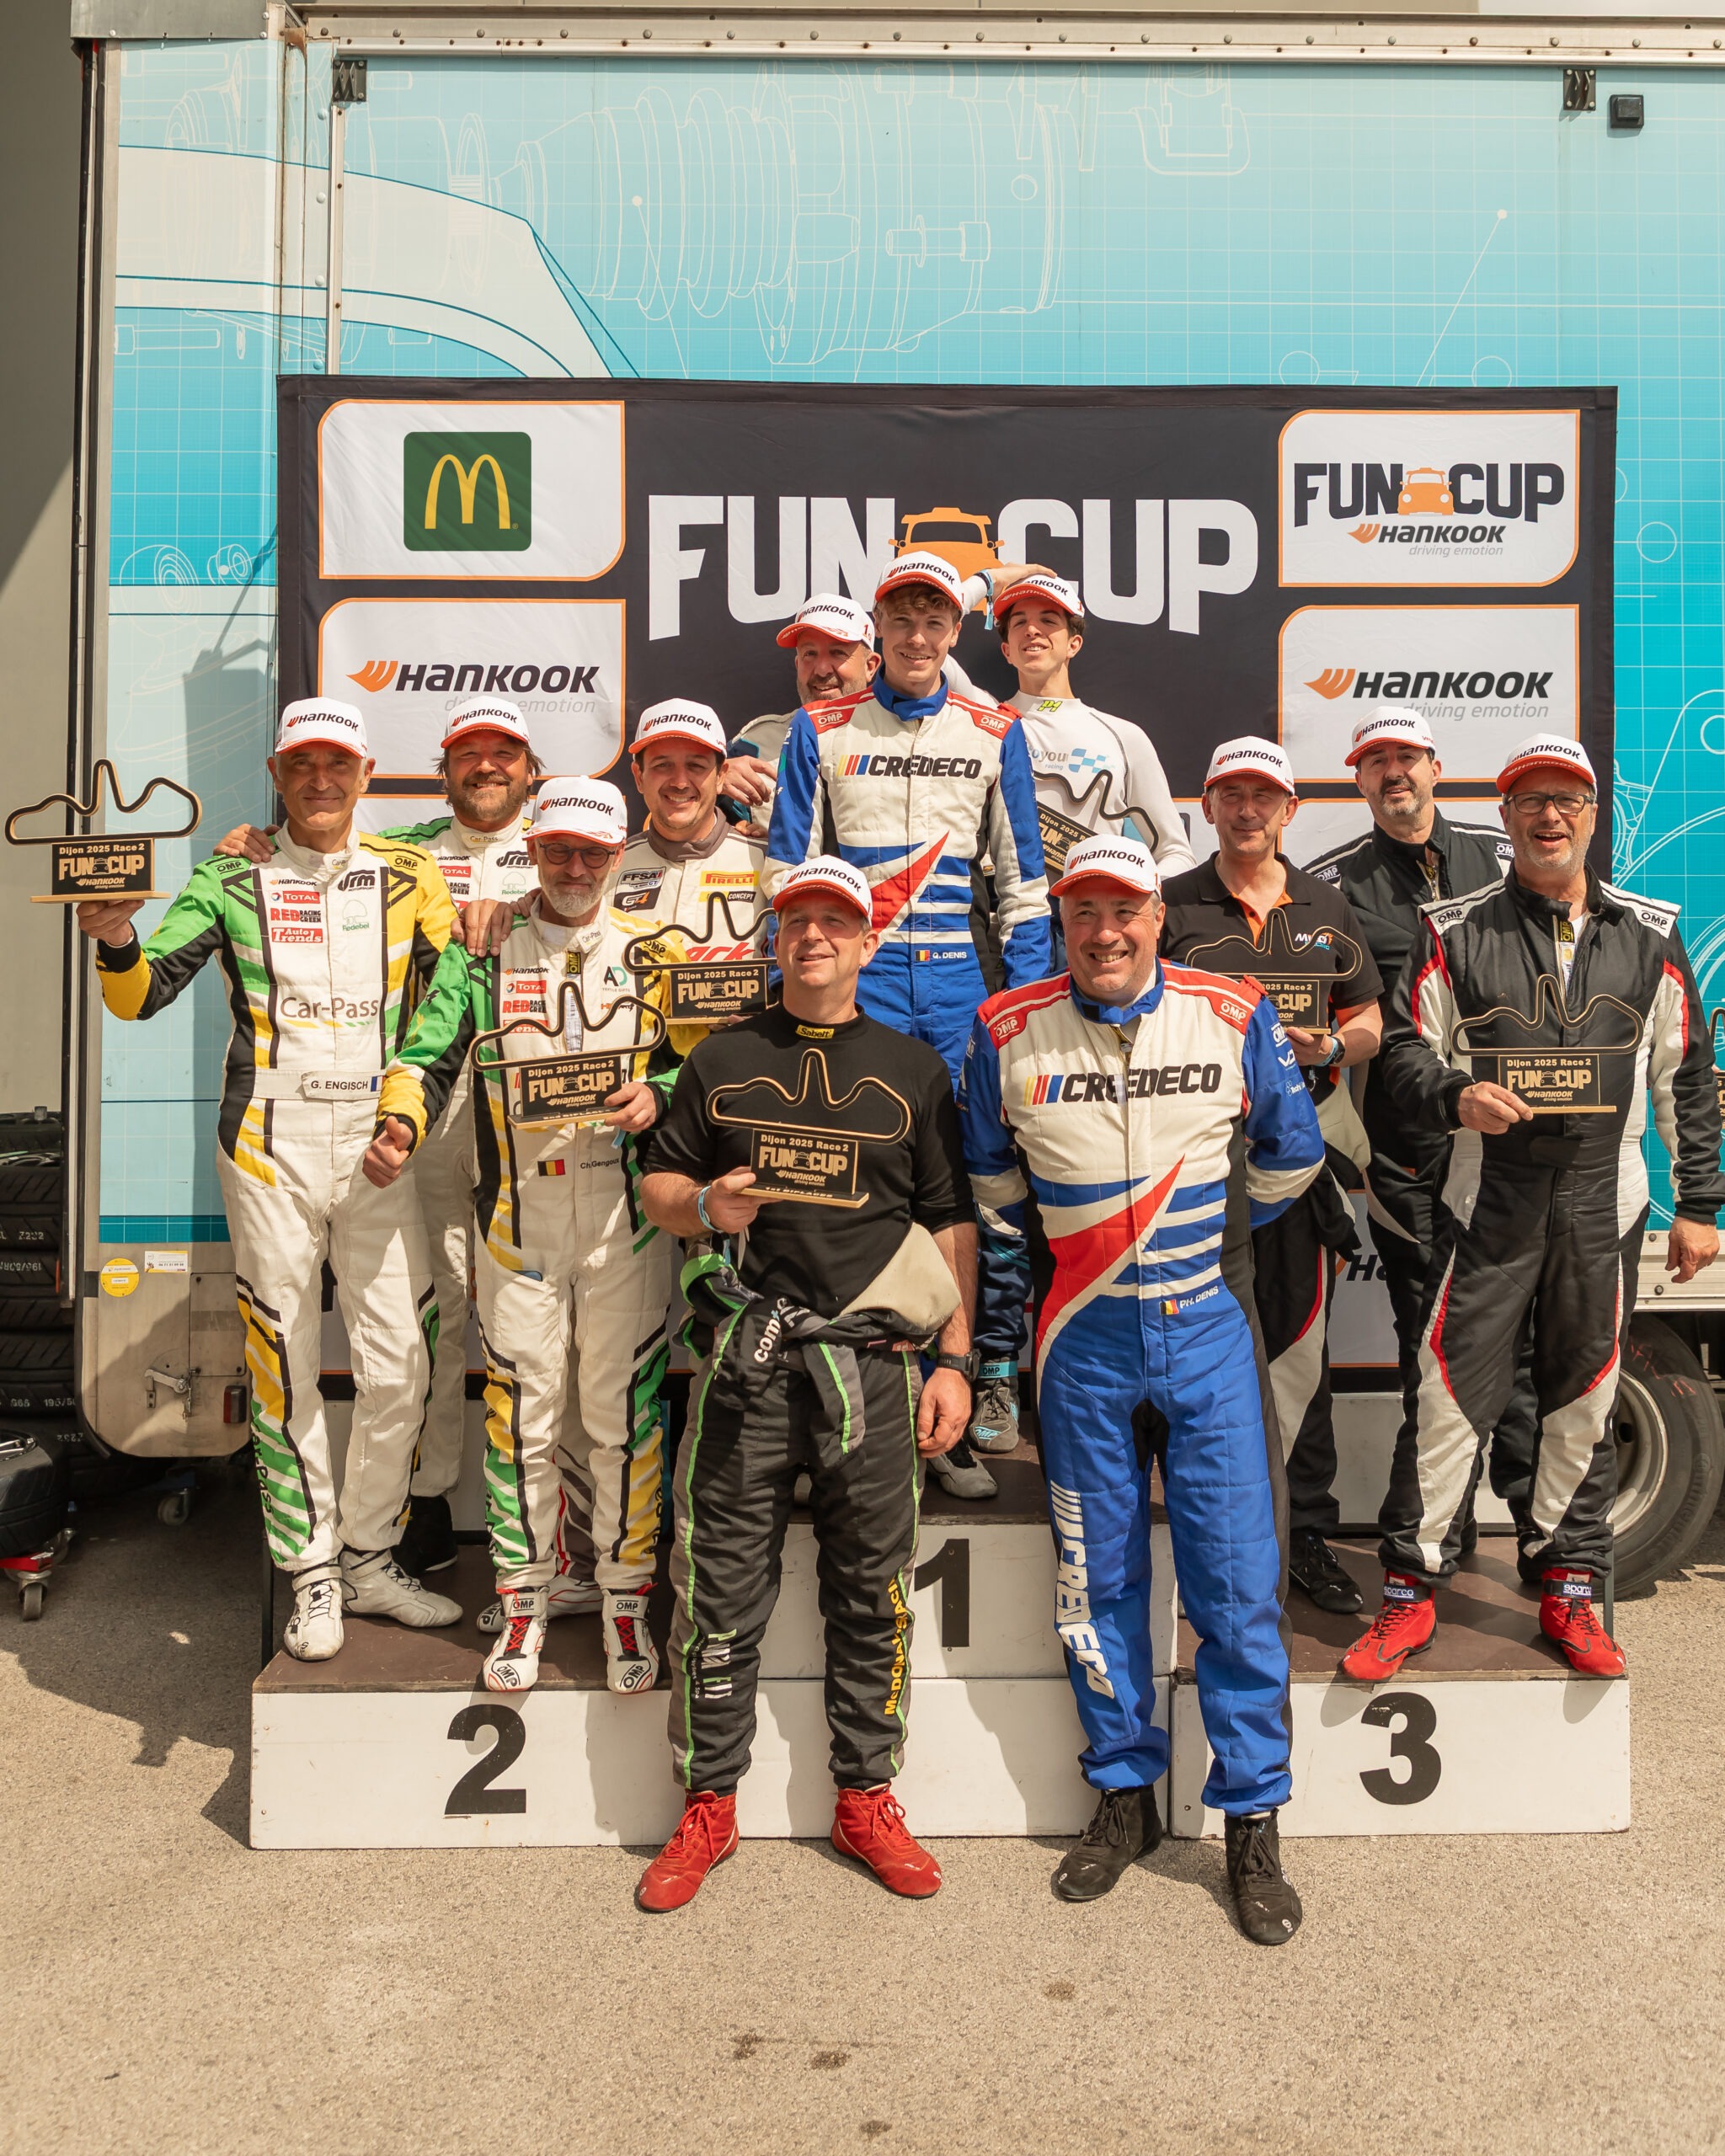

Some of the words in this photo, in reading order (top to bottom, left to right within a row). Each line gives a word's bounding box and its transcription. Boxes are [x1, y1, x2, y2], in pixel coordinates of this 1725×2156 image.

[1294, 463, 1403, 527] FUN
[1449, 463, 1564, 523] CUP
[1408, 545, 1450, 558] driving
[1454, 546, 1503, 556] emotion
[649, 494, 895, 640] FUN
[998, 498, 1258, 635] CUP
[518, 697, 595, 713] emotion
[1471, 702, 1548, 718] emotion
[818, 712, 842, 726] OMP
[980, 715, 1005, 729] OMP
[868, 755, 982, 779] CREDECO
[1039, 812, 1060, 827] Dijon
[1060, 823, 1080, 839] 2025
[59, 846, 84, 856] Dijon
[86, 845, 110, 853] 2025
[113, 844, 137, 852] Race
[59, 857, 94, 880] FUN
[107, 854, 145, 875] CUP
[217, 861, 242, 873] OMP
[394, 857, 418, 868] OMP
[622, 872, 658, 882] FFSA
[706, 873, 755, 884] PIRELLI
[284, 893, 318, 901] TOTAL
[728, 892, 754, 900] CONCEPT
[270, 908, 300, 921] RED
[1438, 908, 1463, 923] OMP
[1641, 911, 1668, 926] OMP
[273, 929, 322, 942] Trends
[285, 927, 309, 936] Auto
[677, 971, 702, 980] Dijon
[704, 970, 726, 979] 2025
[678, 981, 712, 1004] FUN
[724, 979, 760, 999] CUP
[280, 996, 379, 1019] Car-Pass
[502, 1000, 530, 1013] RED
[1279, 993, 1312, 1012] CUP
[1220, 1002, 1247, 1021] OMP
[800, 1027, 830, 1038] Sabelt
[996, 1017, 1018, 1038] OMP
[528, 1068, 553, 1078] Dijon
[556, 1065, 580, 1074] 2025
[583, 1062, 607, 1071] Race
[1507, 1059, 1531, 1068] Dijon
[311, 1081, 322, 1089] G.
[325, 1081, 368, 1091] ENGISCH
[528, 1076, 564, 1102] FUN
[577, 1070, 615, 1092] CUP
[1507, 1070, 1541, 1091] FUN
[1555, 1069, 1592, 1090] CUP
[761, 1134, 786, 1145] Dijon
[789, 1138, 813, 1148] 2025
[816, 1140, 841, 1151] Race
[759, 1145, 796, 1169] FUN
[809, 1151, 848, 1177] CUP
[1195, 1285, 1219, 1303] DENIS
[914, 1538, 970, 1647] 1
[497, 1666, 518, 1687] OMP
[623, 1665, 646, 1689] OMP
[1359, 1691, 1442, 1805] 3
[444, 1703, 526, 1815] 2
